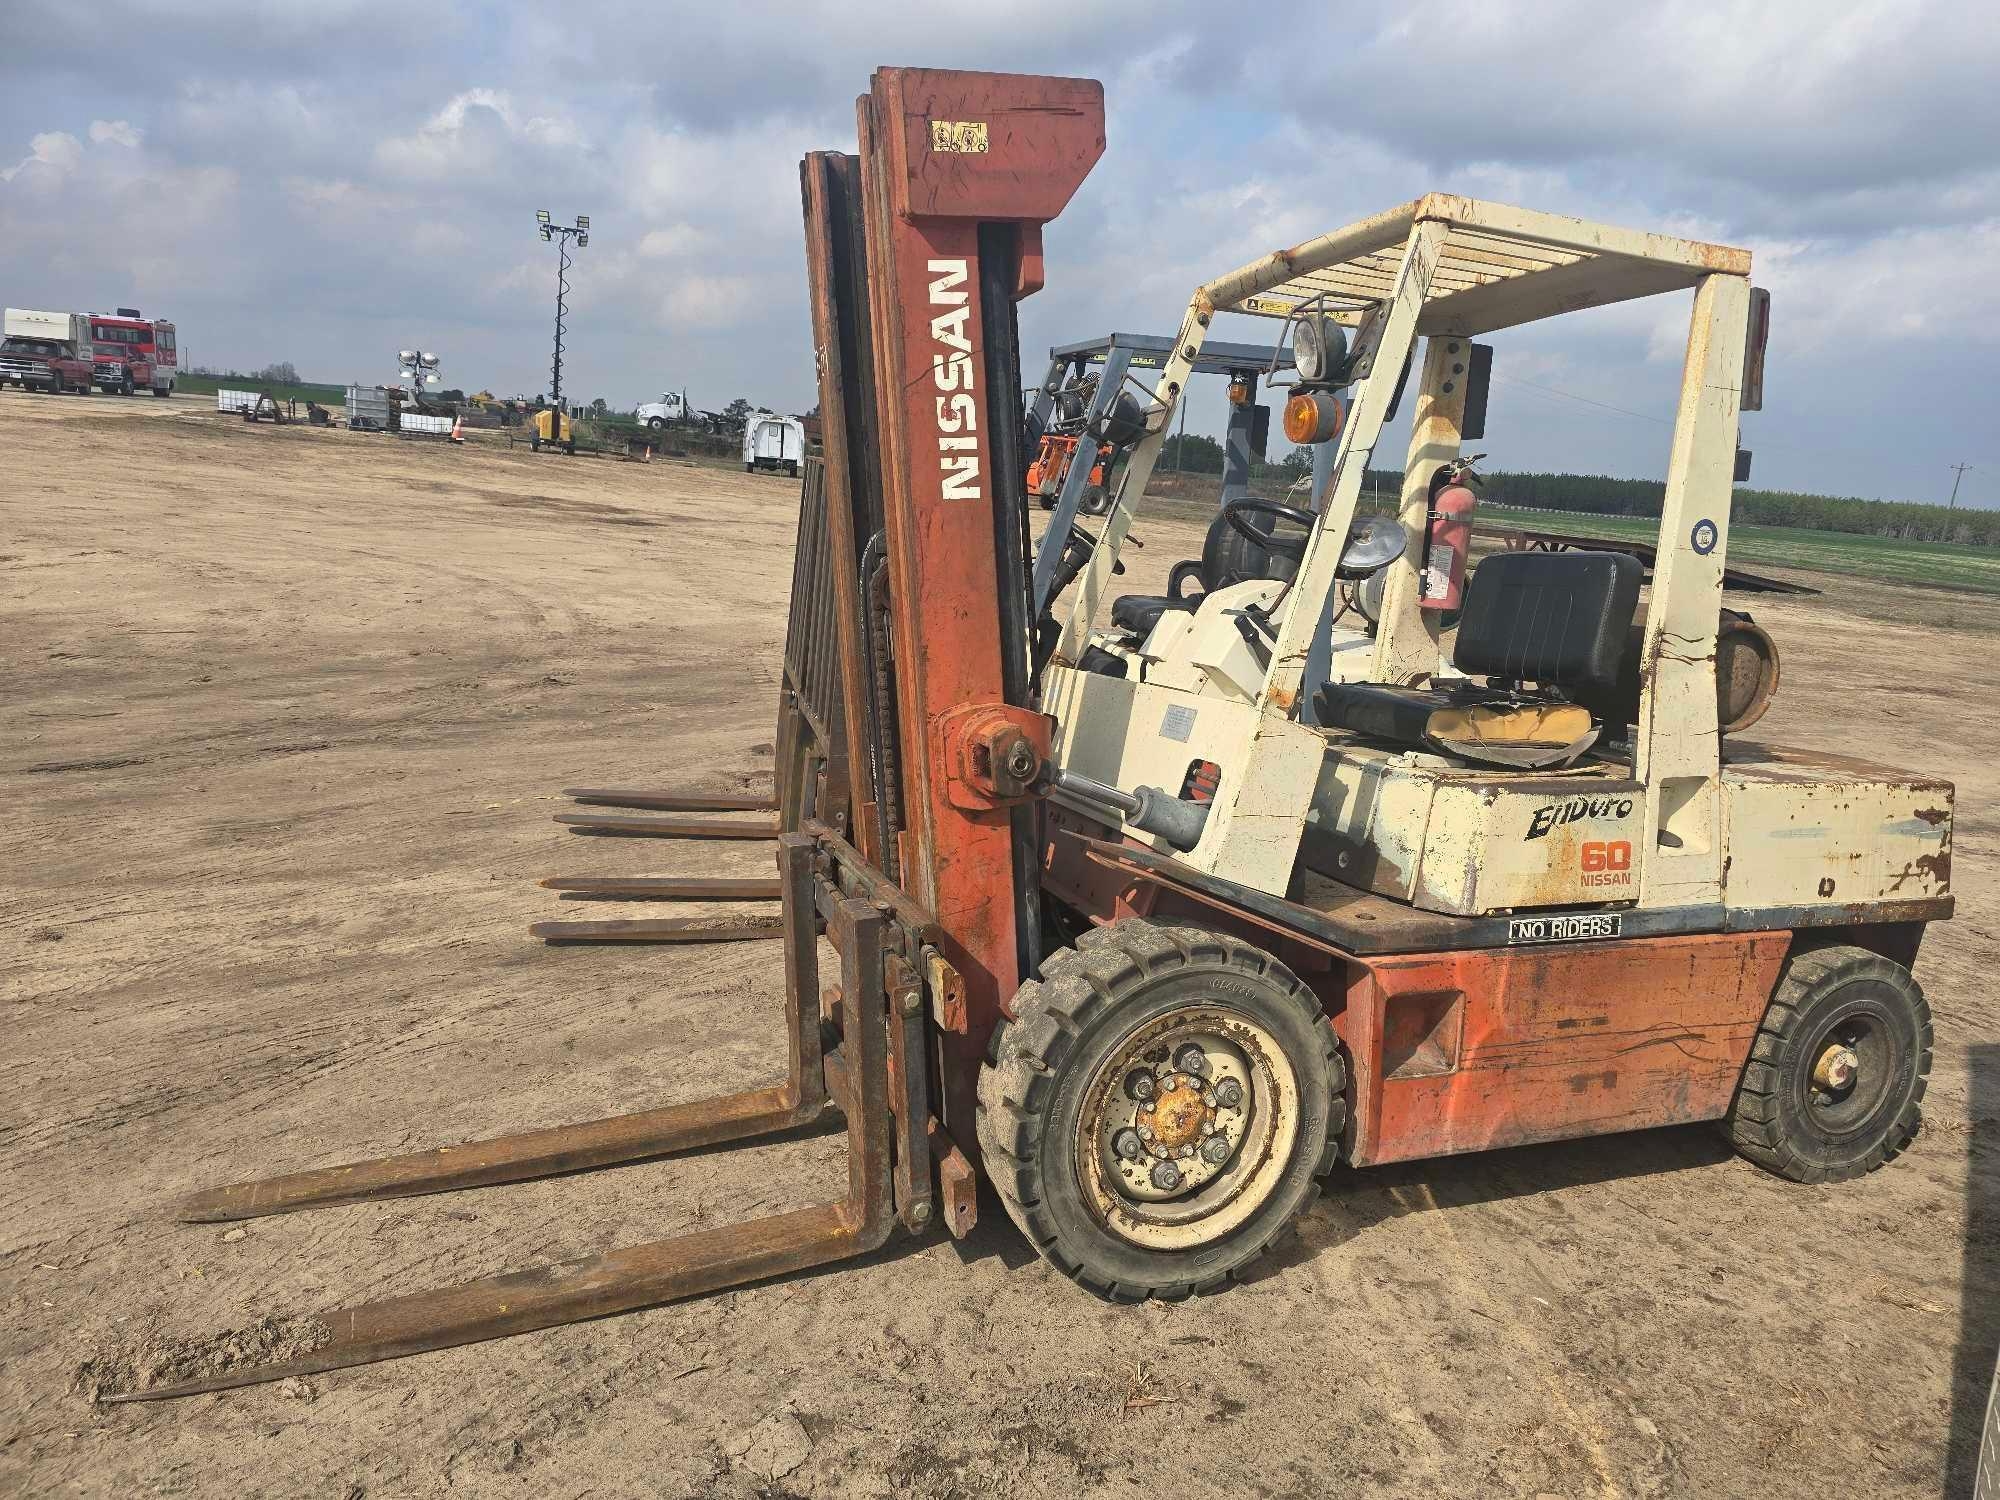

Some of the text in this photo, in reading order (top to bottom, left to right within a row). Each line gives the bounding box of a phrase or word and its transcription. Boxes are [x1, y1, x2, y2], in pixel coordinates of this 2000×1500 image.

[927, 259, 981, 500] NISSAN
[1581, 841, 1632, 872] 60
[1580, 873, 1631, 887] NISSAN
[1519, 917, 1614, 939] NO RIDERS
